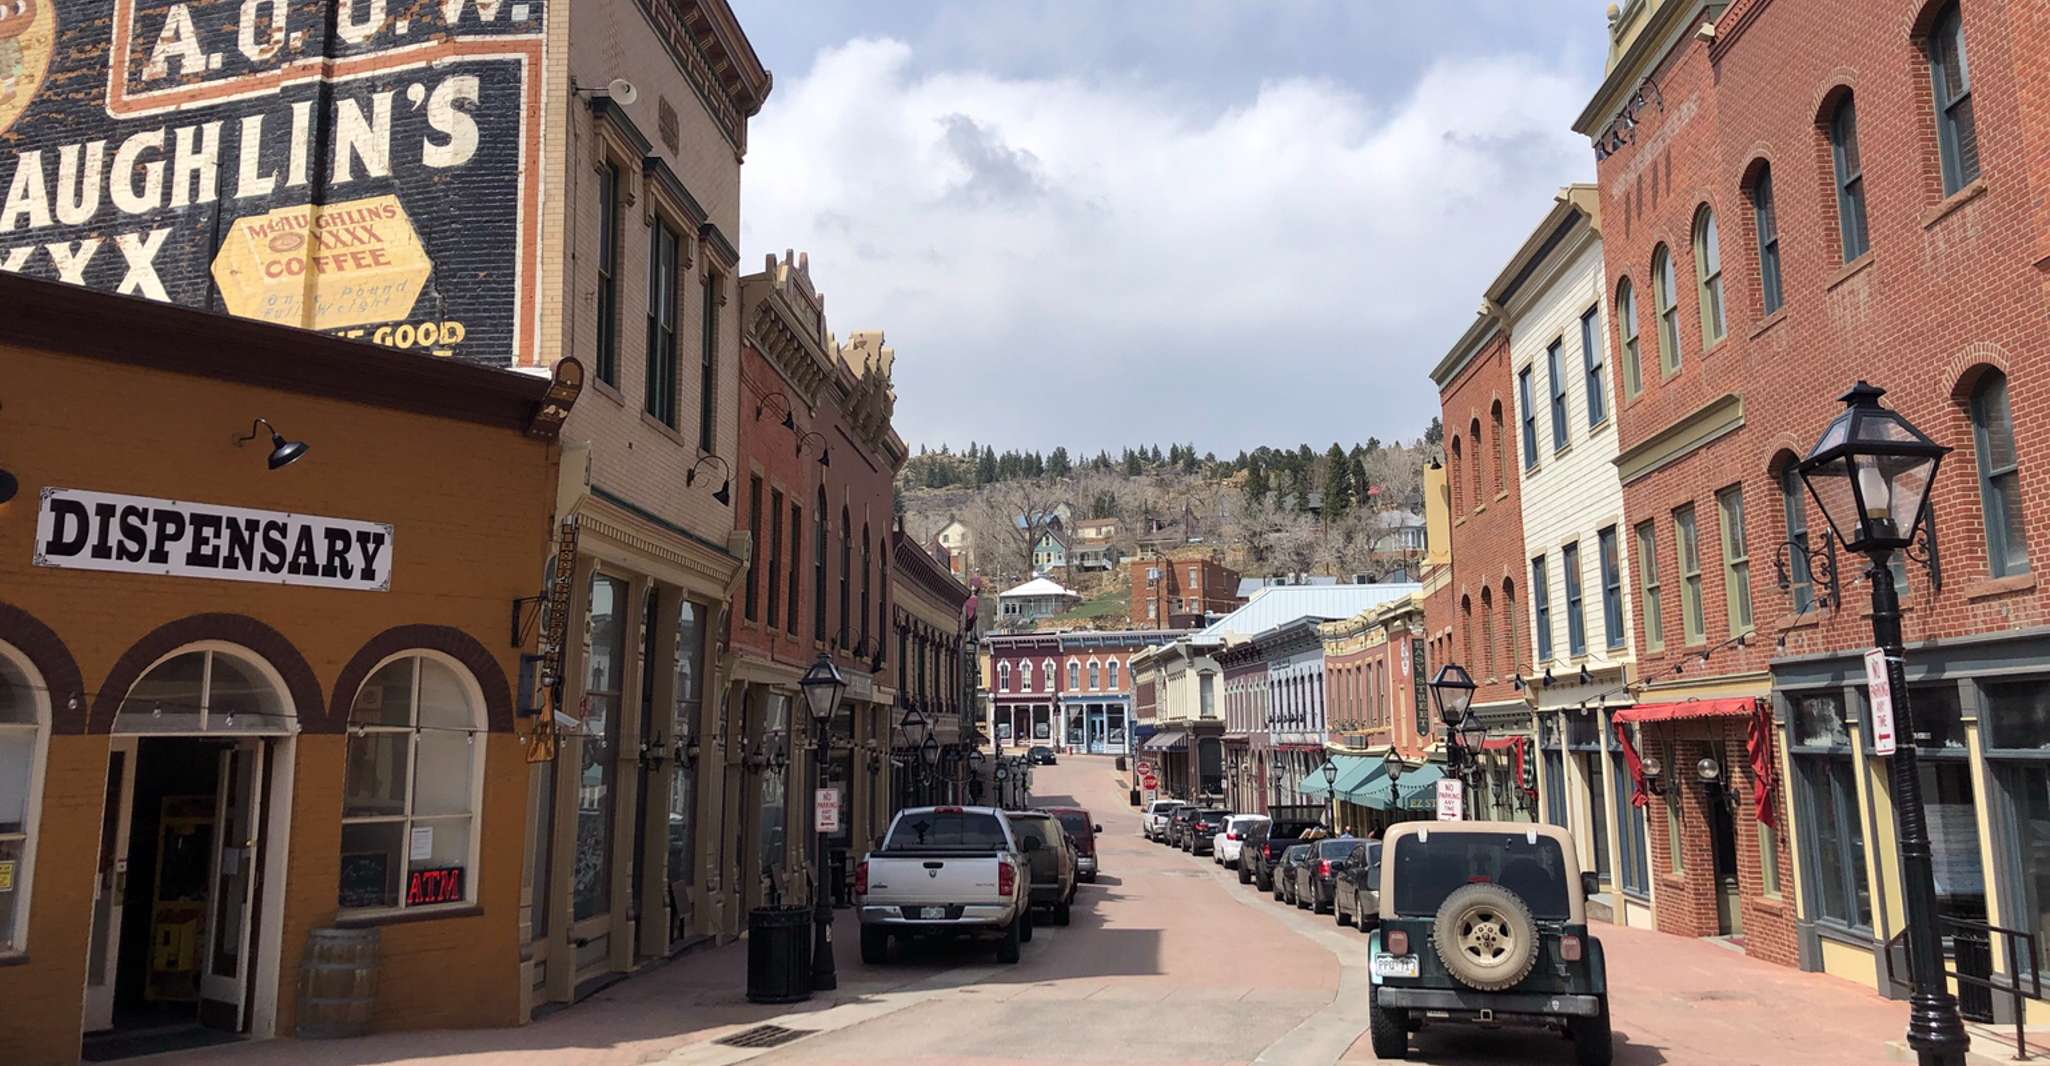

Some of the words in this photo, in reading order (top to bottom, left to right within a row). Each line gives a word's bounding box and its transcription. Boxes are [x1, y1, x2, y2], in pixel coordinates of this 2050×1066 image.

[309, 224, 384, 251] XXXX
[264, 248, 392, 279] COFFEE
[372, 321, 466, 350] GOOD
[45, 498, 385, 581] DISPENSARY
[822, 791, 832, 801] NO
[1439, 791, 1461, 800] PARKING
[1445, 783, 1454, 792] NO
[407, 869, 460, 904] ATM
